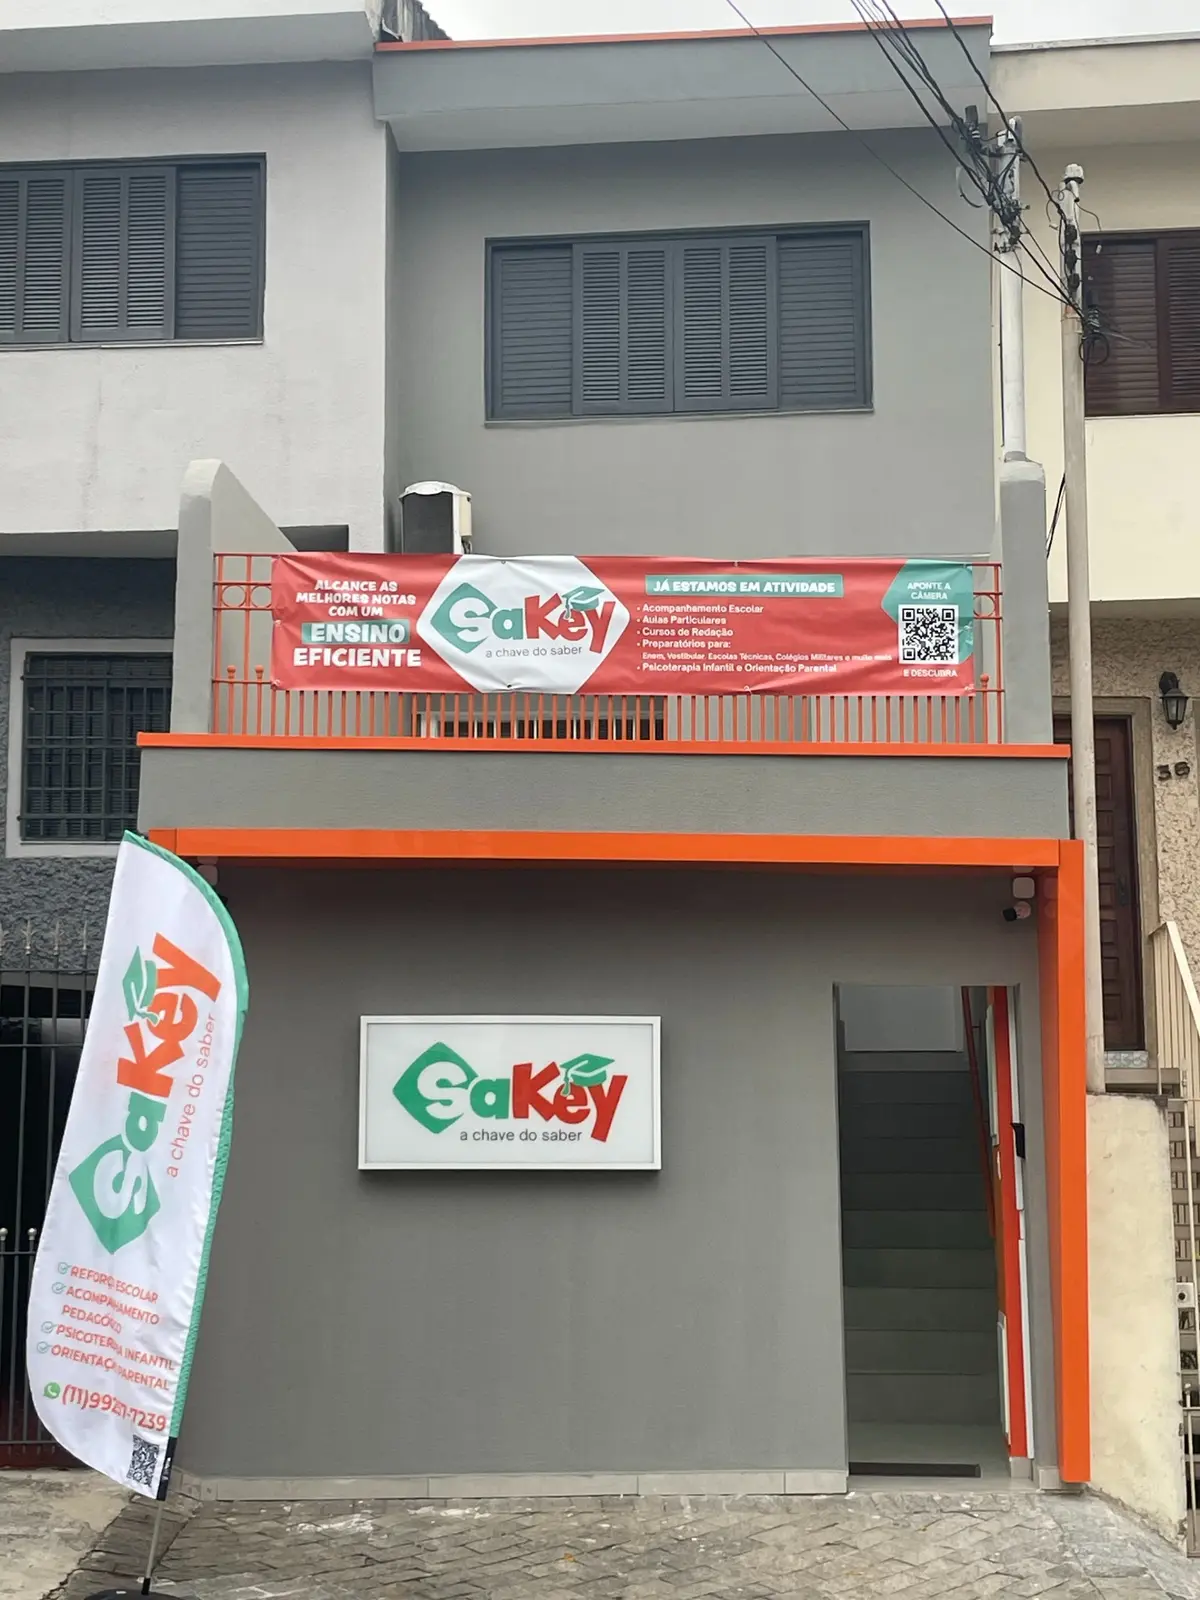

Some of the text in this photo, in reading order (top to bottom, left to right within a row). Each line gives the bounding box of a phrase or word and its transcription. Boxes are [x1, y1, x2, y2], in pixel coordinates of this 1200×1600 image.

[314, 580, 398, 592] ALCANCE AS
[653, 578, 836, 593] JÁ ESTAMOS EM ATIVIDADE
[907, 582, 951, 590] APONTE A
[295, 592, 417, 605] MELHORES NOTAS
[910, 590, 948, 600] CÂMERA
[328, 605, 384, 617] COM UM
[642, 603, 764, 614] Acompanhamento Escolar
[642, 615, 727, 624] Aulas Particulares
[311, 623, 405, 643] ENSINO
[642, 627, 734, 638] Cursos de Redação
[642, 638, 731, 650] Preparatórios para:
[293, 647, 422, 667] EFICIENTE
[485, 645, 583, 658] a chave do saber
[775, 653, 809, 662] Colégios
[810, 653, 844, 661] Militares
[642, 662, 838, 675] Psicoterapia Infantil e Orientação Parental
[903, 670, 958, 678] E DESCUBRA
[166, 1012, 217, 1178] a chave do saber
[459, 1128, 583, 1142] a chave do saber
[70, 1266, 159, 1304] REFORÇ ESCOLAR
[124, 1347, 175, 1371] INFANTIL
